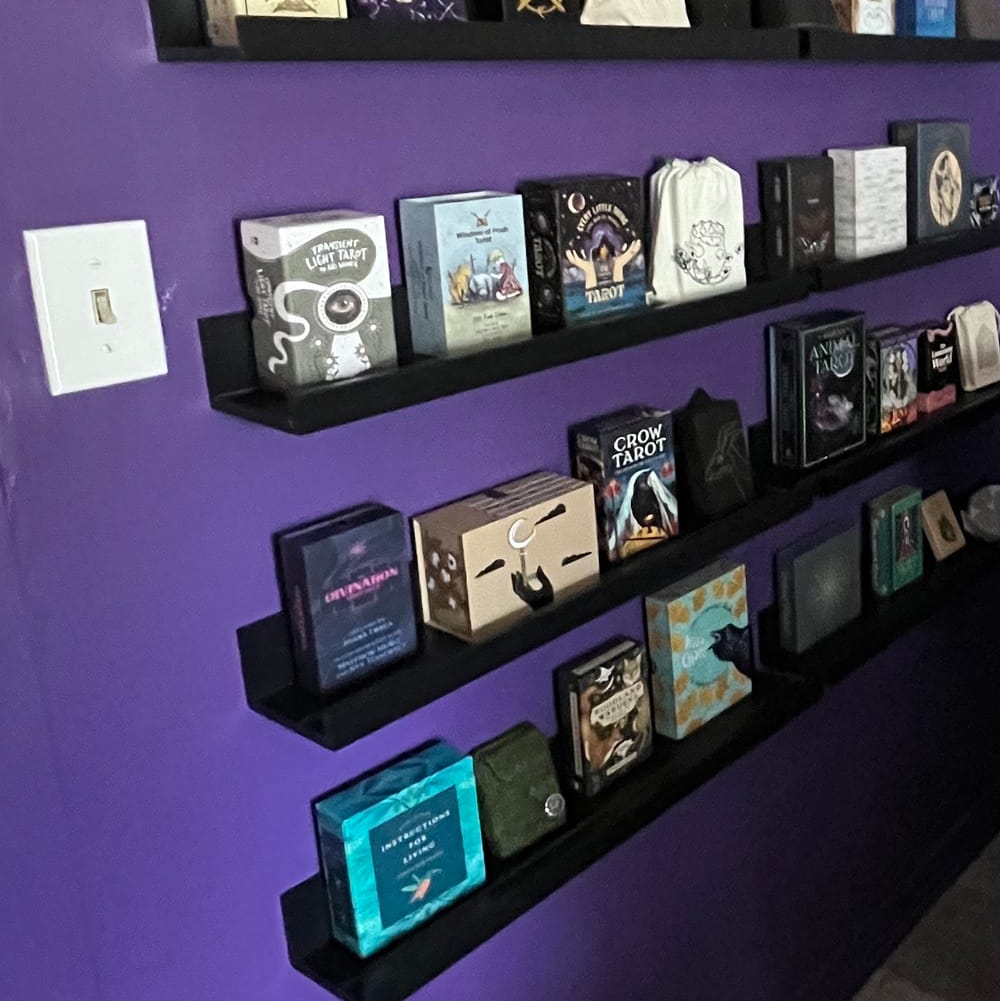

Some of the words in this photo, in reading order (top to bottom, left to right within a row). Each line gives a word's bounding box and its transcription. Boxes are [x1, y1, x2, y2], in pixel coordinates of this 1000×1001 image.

[592, 203, 613, 215] LITTLE
[305, 251, 336, 271] LIGHT
[338, 247, 367, 261] TAROT
[311, 238, 361, 256] TRANSIENT
[585, 284, 625, 304] TAROT
[613, 423, 663, 452] CROW
[611, 437, 667, 468] TAROT
[324, 567, 399, 604] DIVINATION
[381, 809, 451, 853] INSTRUCTIONS
[408, 834, 428, 850] FOR
[402, 840, 436, 865] LIVING
